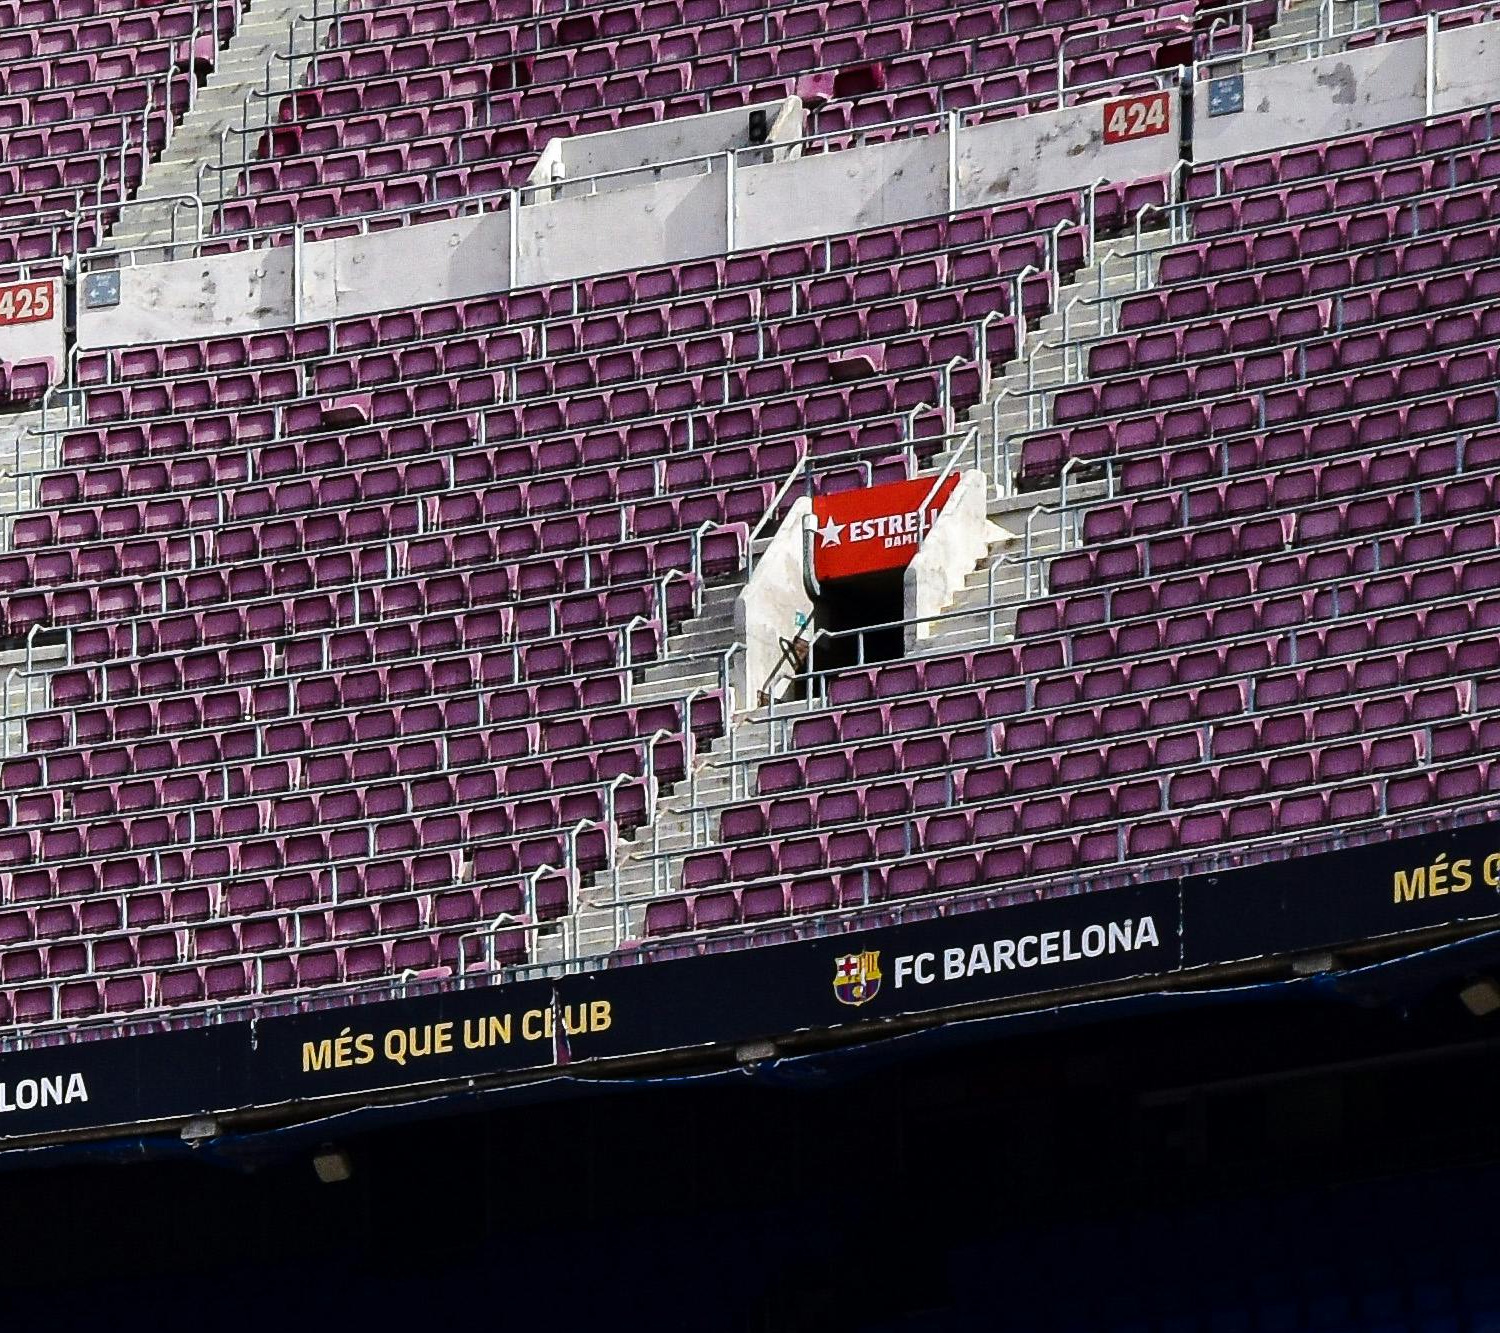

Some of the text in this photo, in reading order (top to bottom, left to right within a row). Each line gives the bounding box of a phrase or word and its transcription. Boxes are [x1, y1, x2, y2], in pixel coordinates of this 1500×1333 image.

[1108, 99, 1165, 137] 424
[1394, 852, 1472, 904] MÉS
[894, 916, 1160, 989] FC BARCELONA
[302, 1026, 375, 1072] MÉS
[384, 1021, 453, 1066] QUE
[463, 1014, 512, 1049] UN
